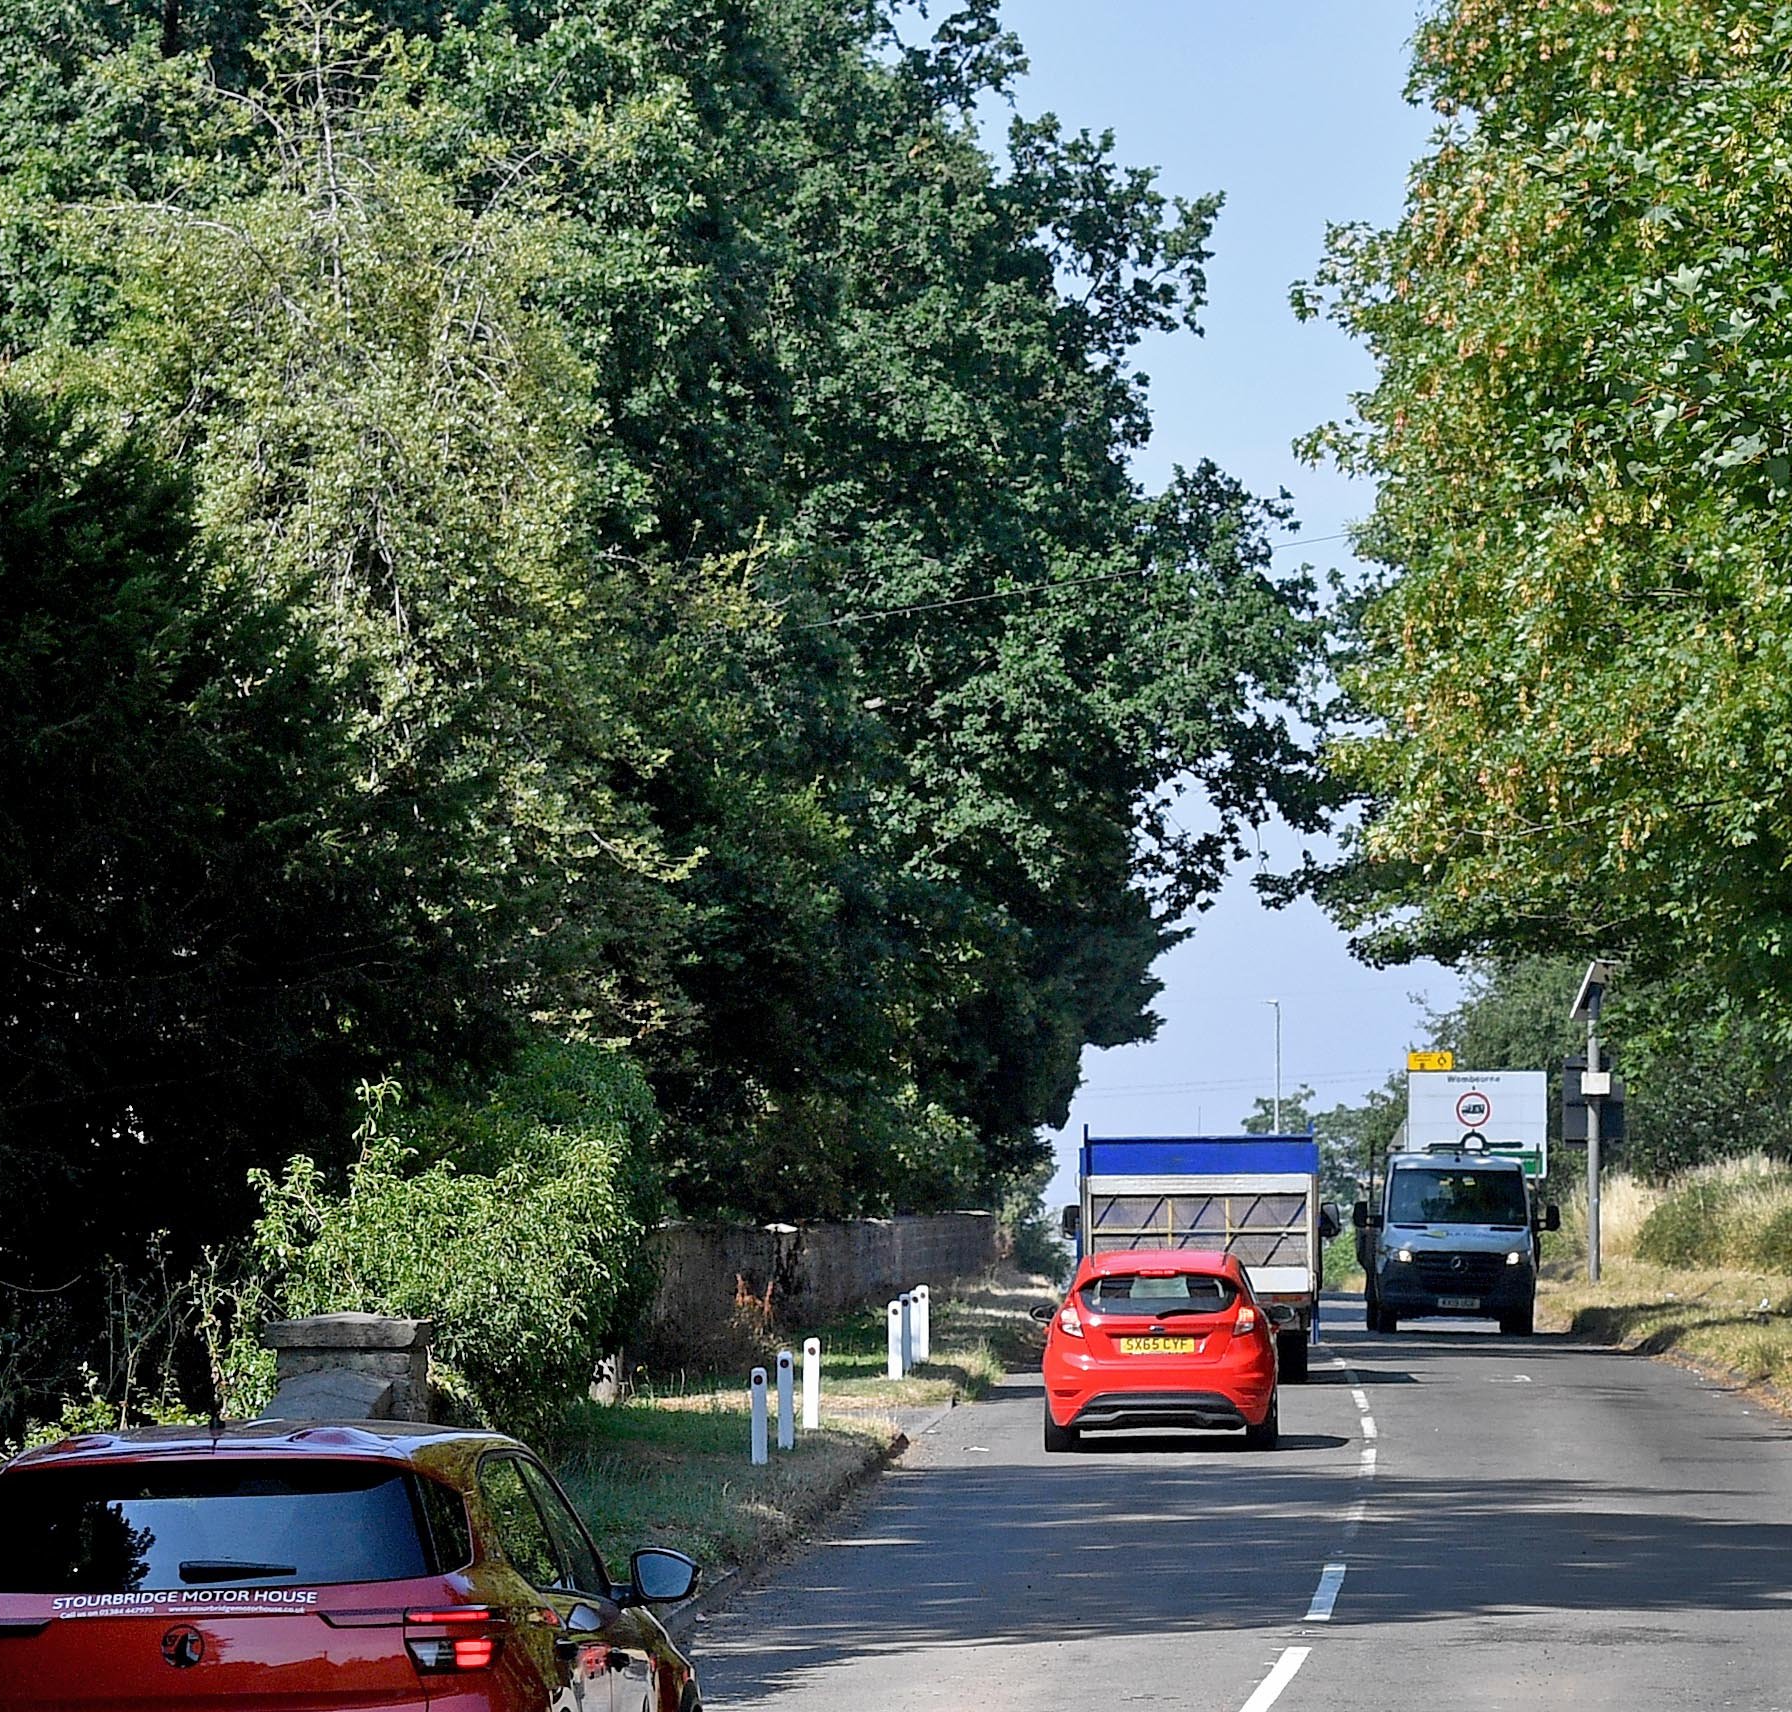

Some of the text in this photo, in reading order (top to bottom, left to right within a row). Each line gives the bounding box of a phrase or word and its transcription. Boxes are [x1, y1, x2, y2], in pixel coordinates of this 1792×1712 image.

[1126, 1337, 1188, 1350] SX65 CYF
[52, 1590, 318, 1610] STOURBRIDGE MOTOR HOUSE
